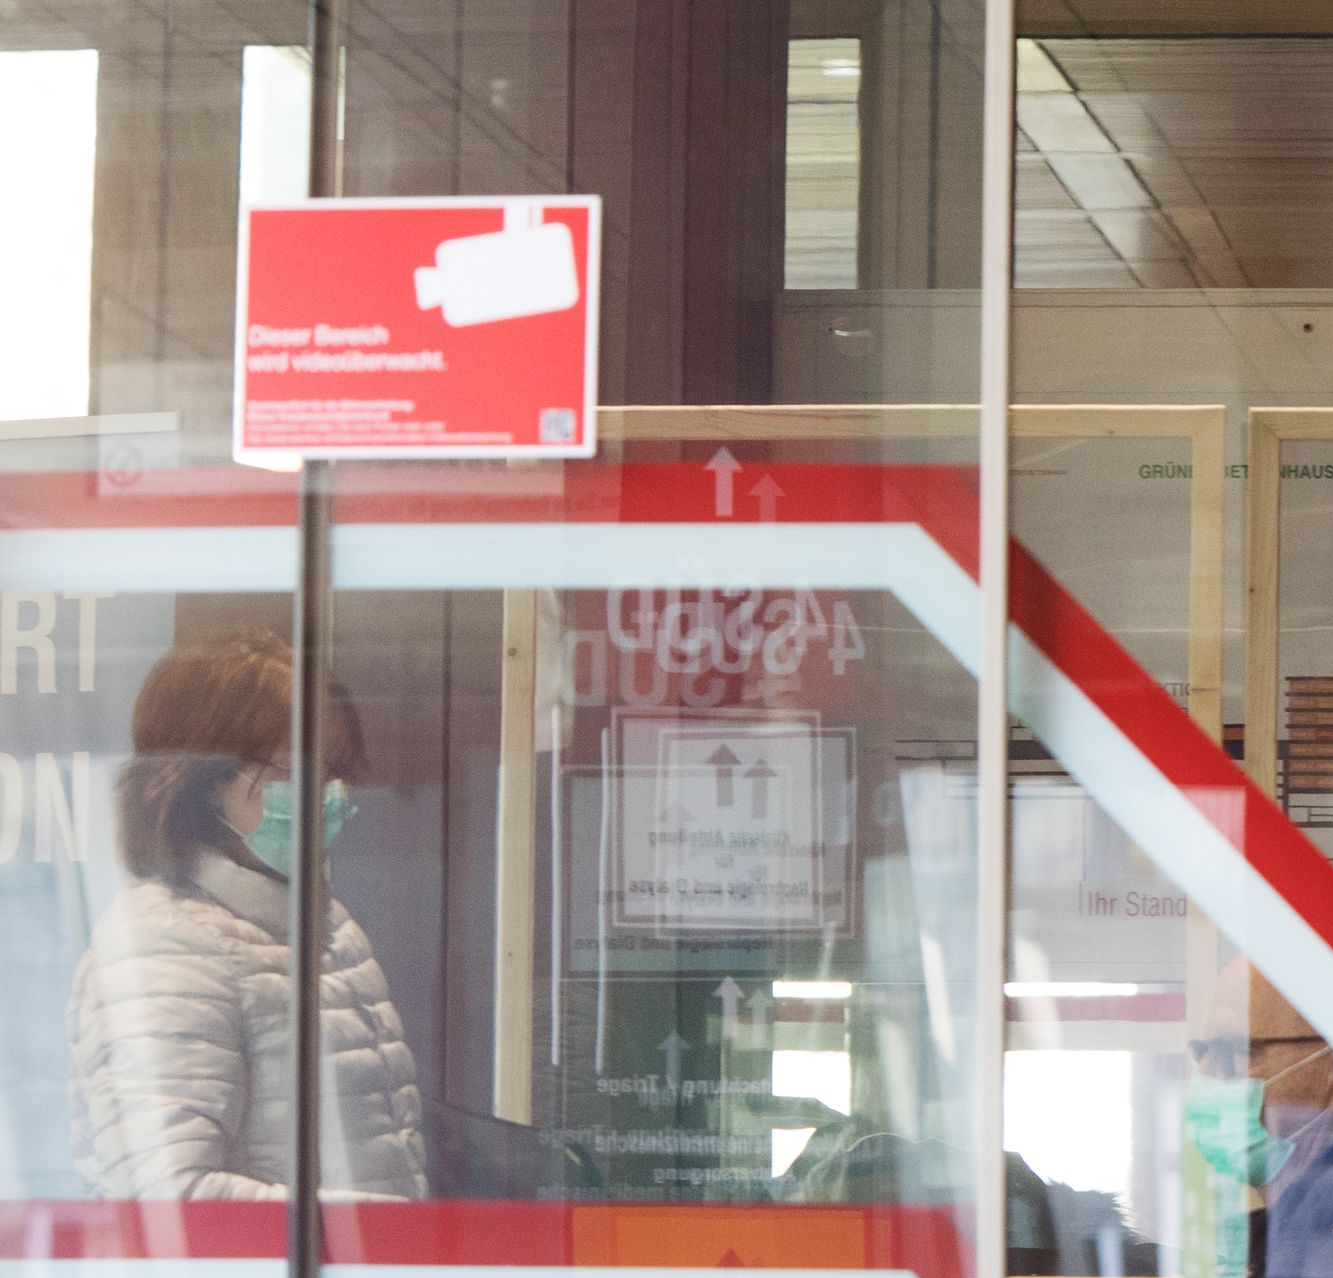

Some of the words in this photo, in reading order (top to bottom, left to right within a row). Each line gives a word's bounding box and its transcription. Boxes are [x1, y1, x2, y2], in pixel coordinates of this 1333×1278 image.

[248, 324, 311, 347] Dieser
[314, 323, 388, 347] Bereich
[248, 350, 289, 372] wird
[1138, 461, 1192, 479] GRÜN
[1223, 464, 1333, 479] ETNHAUS
[1087, 890, 1117, 917] Ihr
